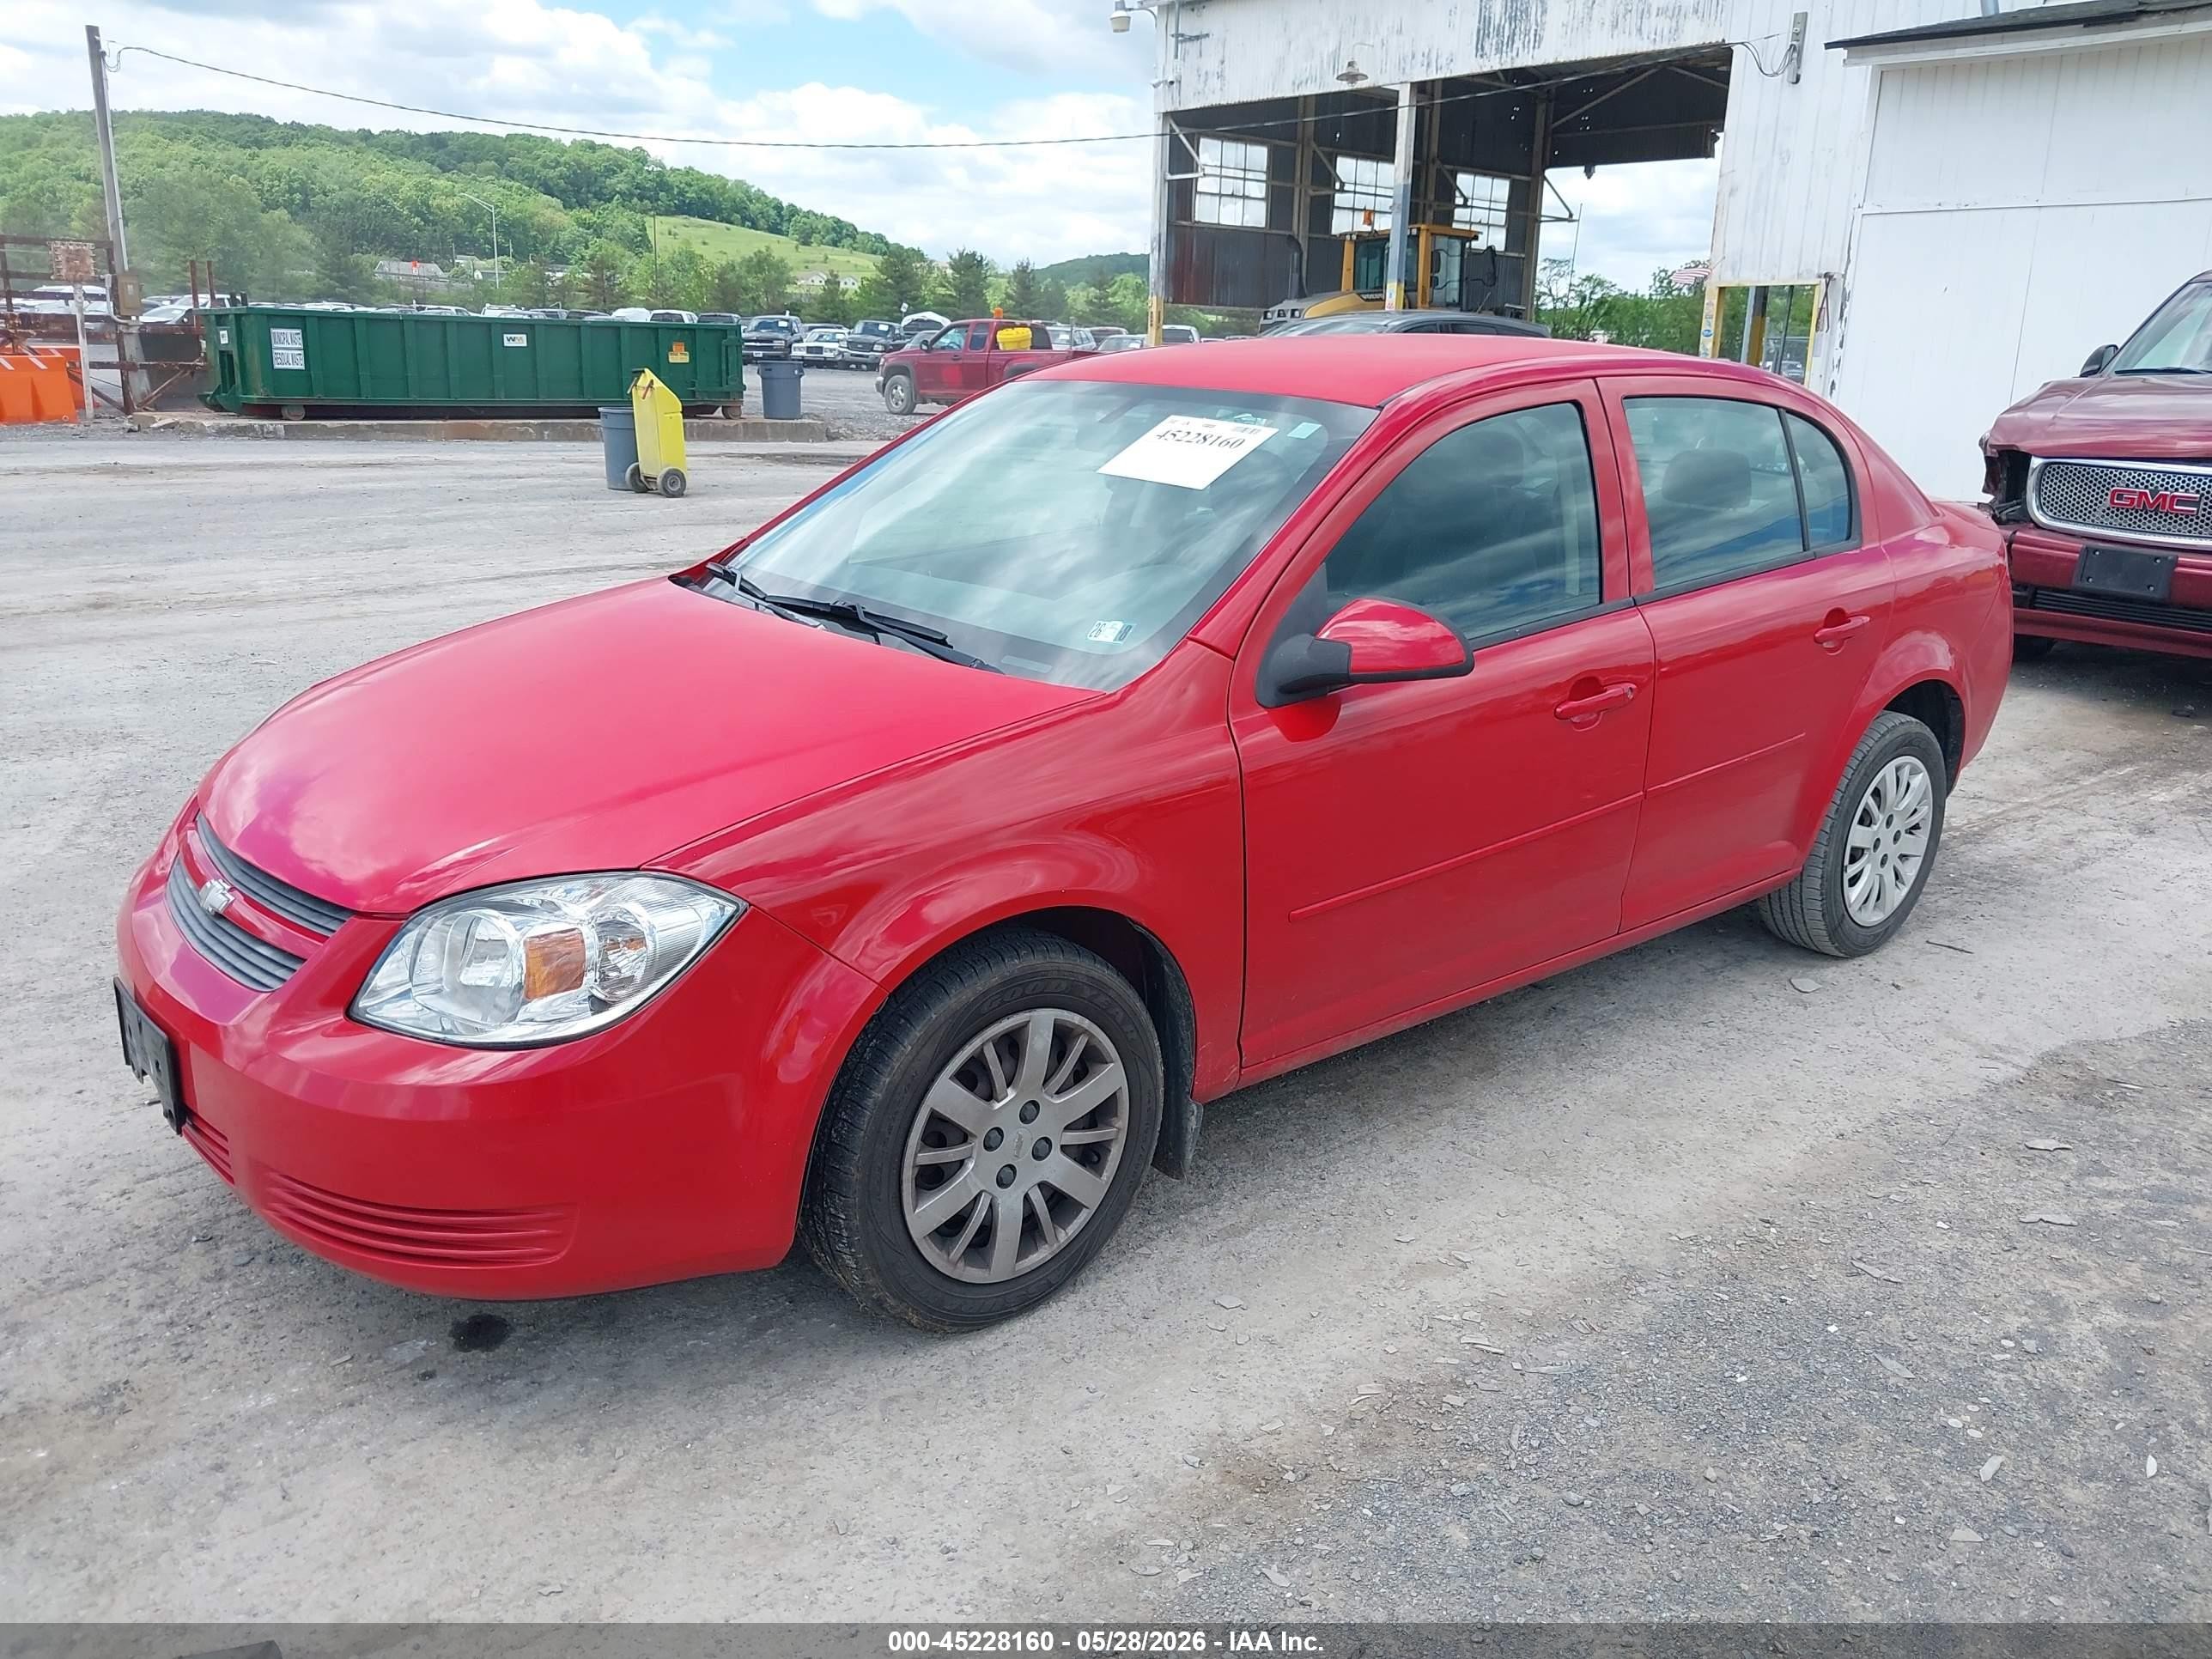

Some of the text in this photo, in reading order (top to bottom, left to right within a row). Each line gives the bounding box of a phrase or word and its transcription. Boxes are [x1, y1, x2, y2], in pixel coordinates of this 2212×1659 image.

[291, 353, 303, 366] WASTE
[1156, 429, 1246, 449] 45228160
[2109, 487, 2200, 515] GMC
